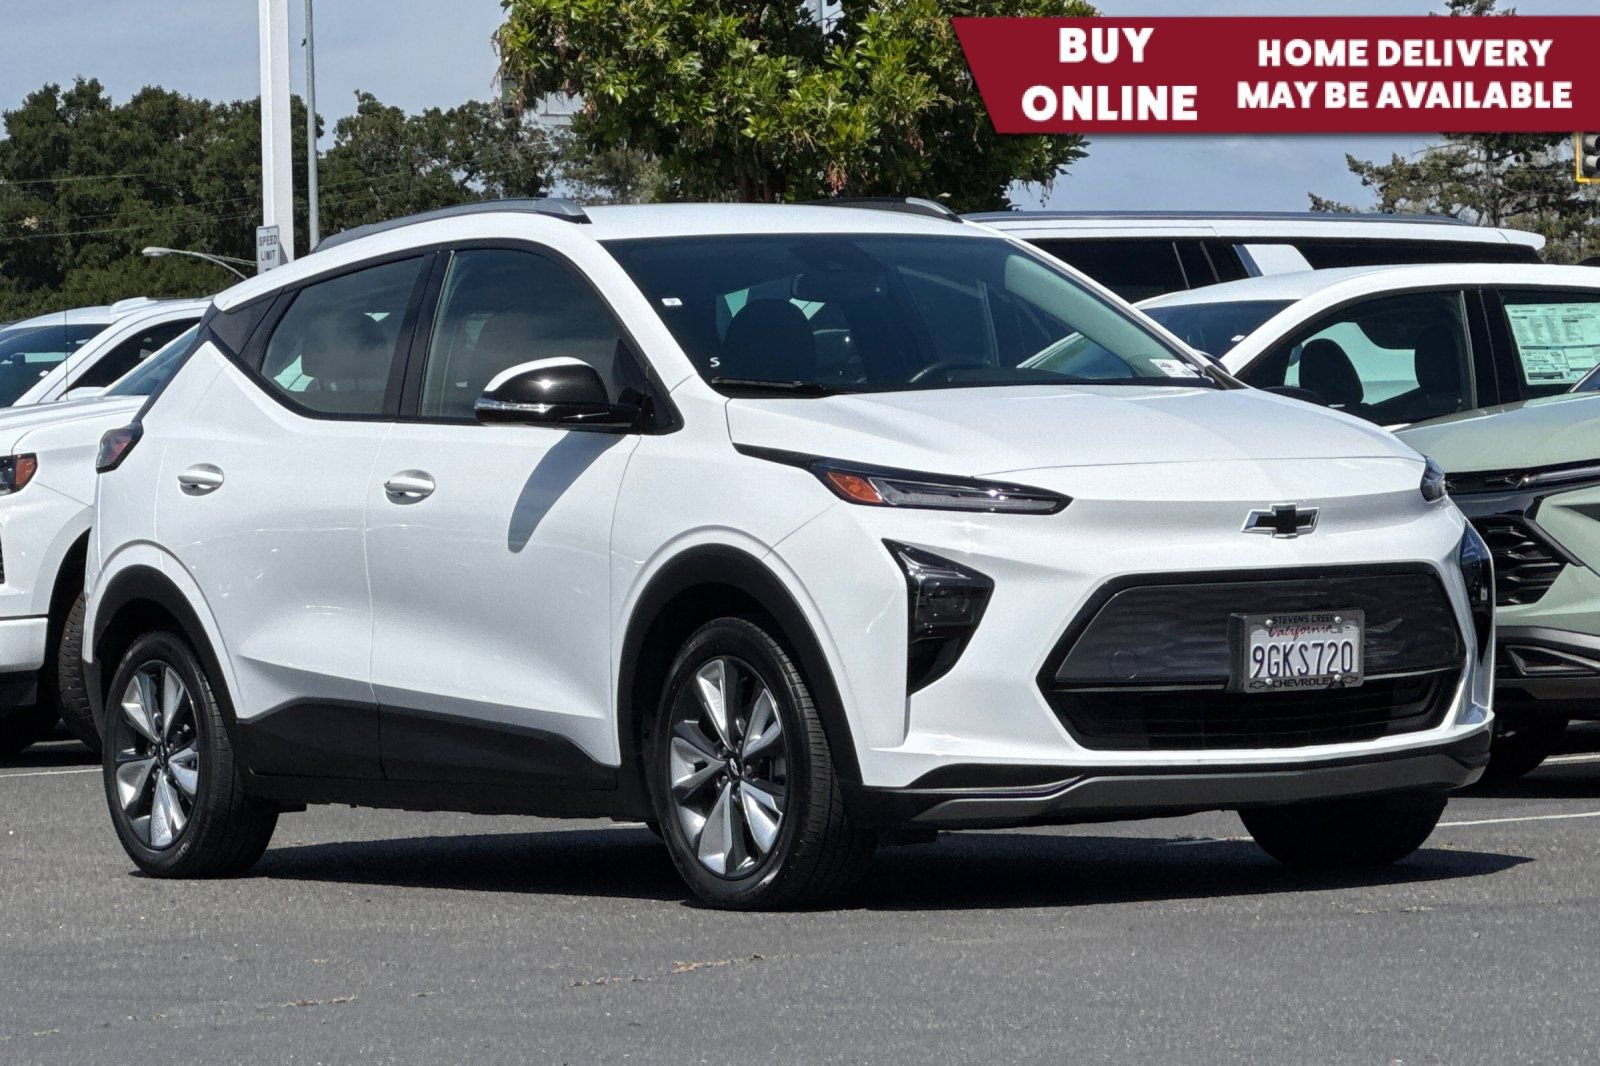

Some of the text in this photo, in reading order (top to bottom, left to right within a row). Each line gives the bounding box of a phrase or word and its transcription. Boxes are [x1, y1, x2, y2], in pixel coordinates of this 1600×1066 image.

[259, 235, 278, 246] SPEED
[1272, 614, 1309, 624] STEVENS
[1269, 625, 1332, 641] California
[1252, 641, 1353, 678] 9GKS720
